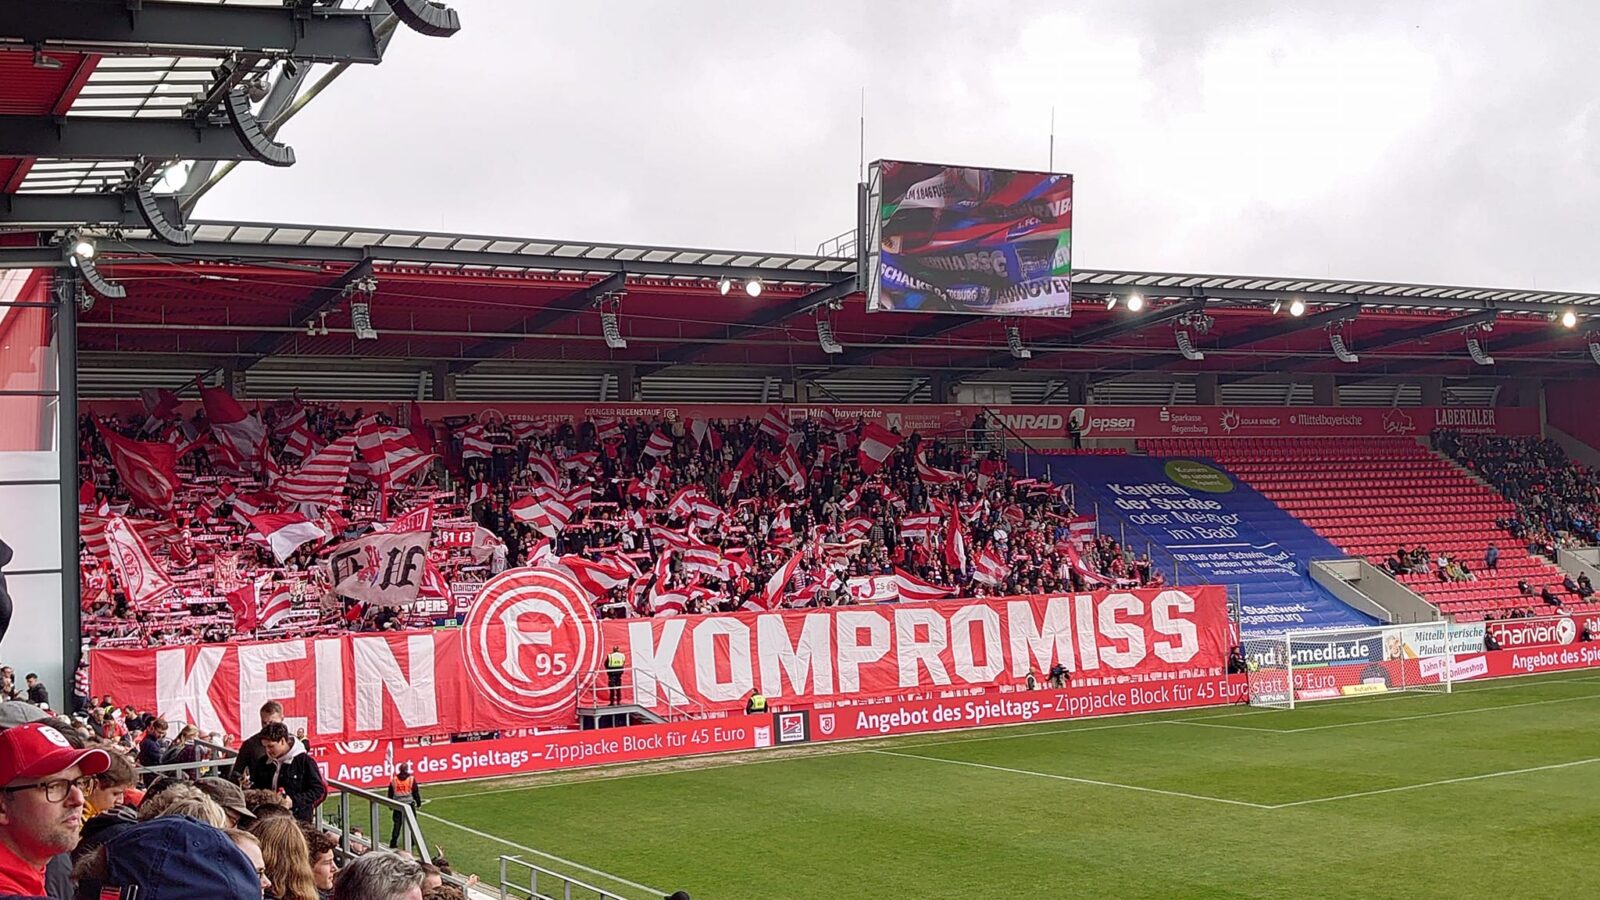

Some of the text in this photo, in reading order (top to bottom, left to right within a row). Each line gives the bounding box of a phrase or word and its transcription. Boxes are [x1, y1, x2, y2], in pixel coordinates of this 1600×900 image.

[881, 263, 933, 292] SCHALKE
[616, 408, 661, 416] REGENSTAUF
[1171, 413, 1202, 423] Sparkasse
[1435, 409, 1496, 425] LABERTALER
[1298, 413, 1362, 426] Mittelbayerische
[1171, 425, 1208, 435] Regensburg
[1107, 483, 1191, 497] Kapitän
[1114, 498, 1222, 510] der Straße
[1129, 512, 1172, 525] oder
[1163, 527, 1196, 540] im
[1188, 553, 1209, 561] Bus
[628, 590, 1199, 707] KOMPROMISS
[535, 653, 567, 676] 95
[1512, 653, 1559, 671] Angebot
[1561, 650, 1579, 664] des
[156, 635, 438, 741] KEIN
[856, 707, 929, 733] Angebot
[932, 704, 962, 723] des
[965, 699, 1040, 725] Spieltags
[1055, 691, 1126, 715] Zippjacke
[1130, 686, 1169, 704] Block
[1172, 684, 1193, 701] für
[1196, 683, 1214, 699] 45
[1253, 678, 1284, 694] statt
[1307, 672, 1336, 689] Euro
[337, 760, 413, 783] Angebot
[418, 754, 448, 773] des
[452, 749, 529, 773] Spieltags
[544, 737, 619, 762] Zippjacke
[623, 732, 663, 750] Block
[666, 730, 687, 747] für
[691, 728, 710, 744] 45
[714, 727, 746, 743] Euro
